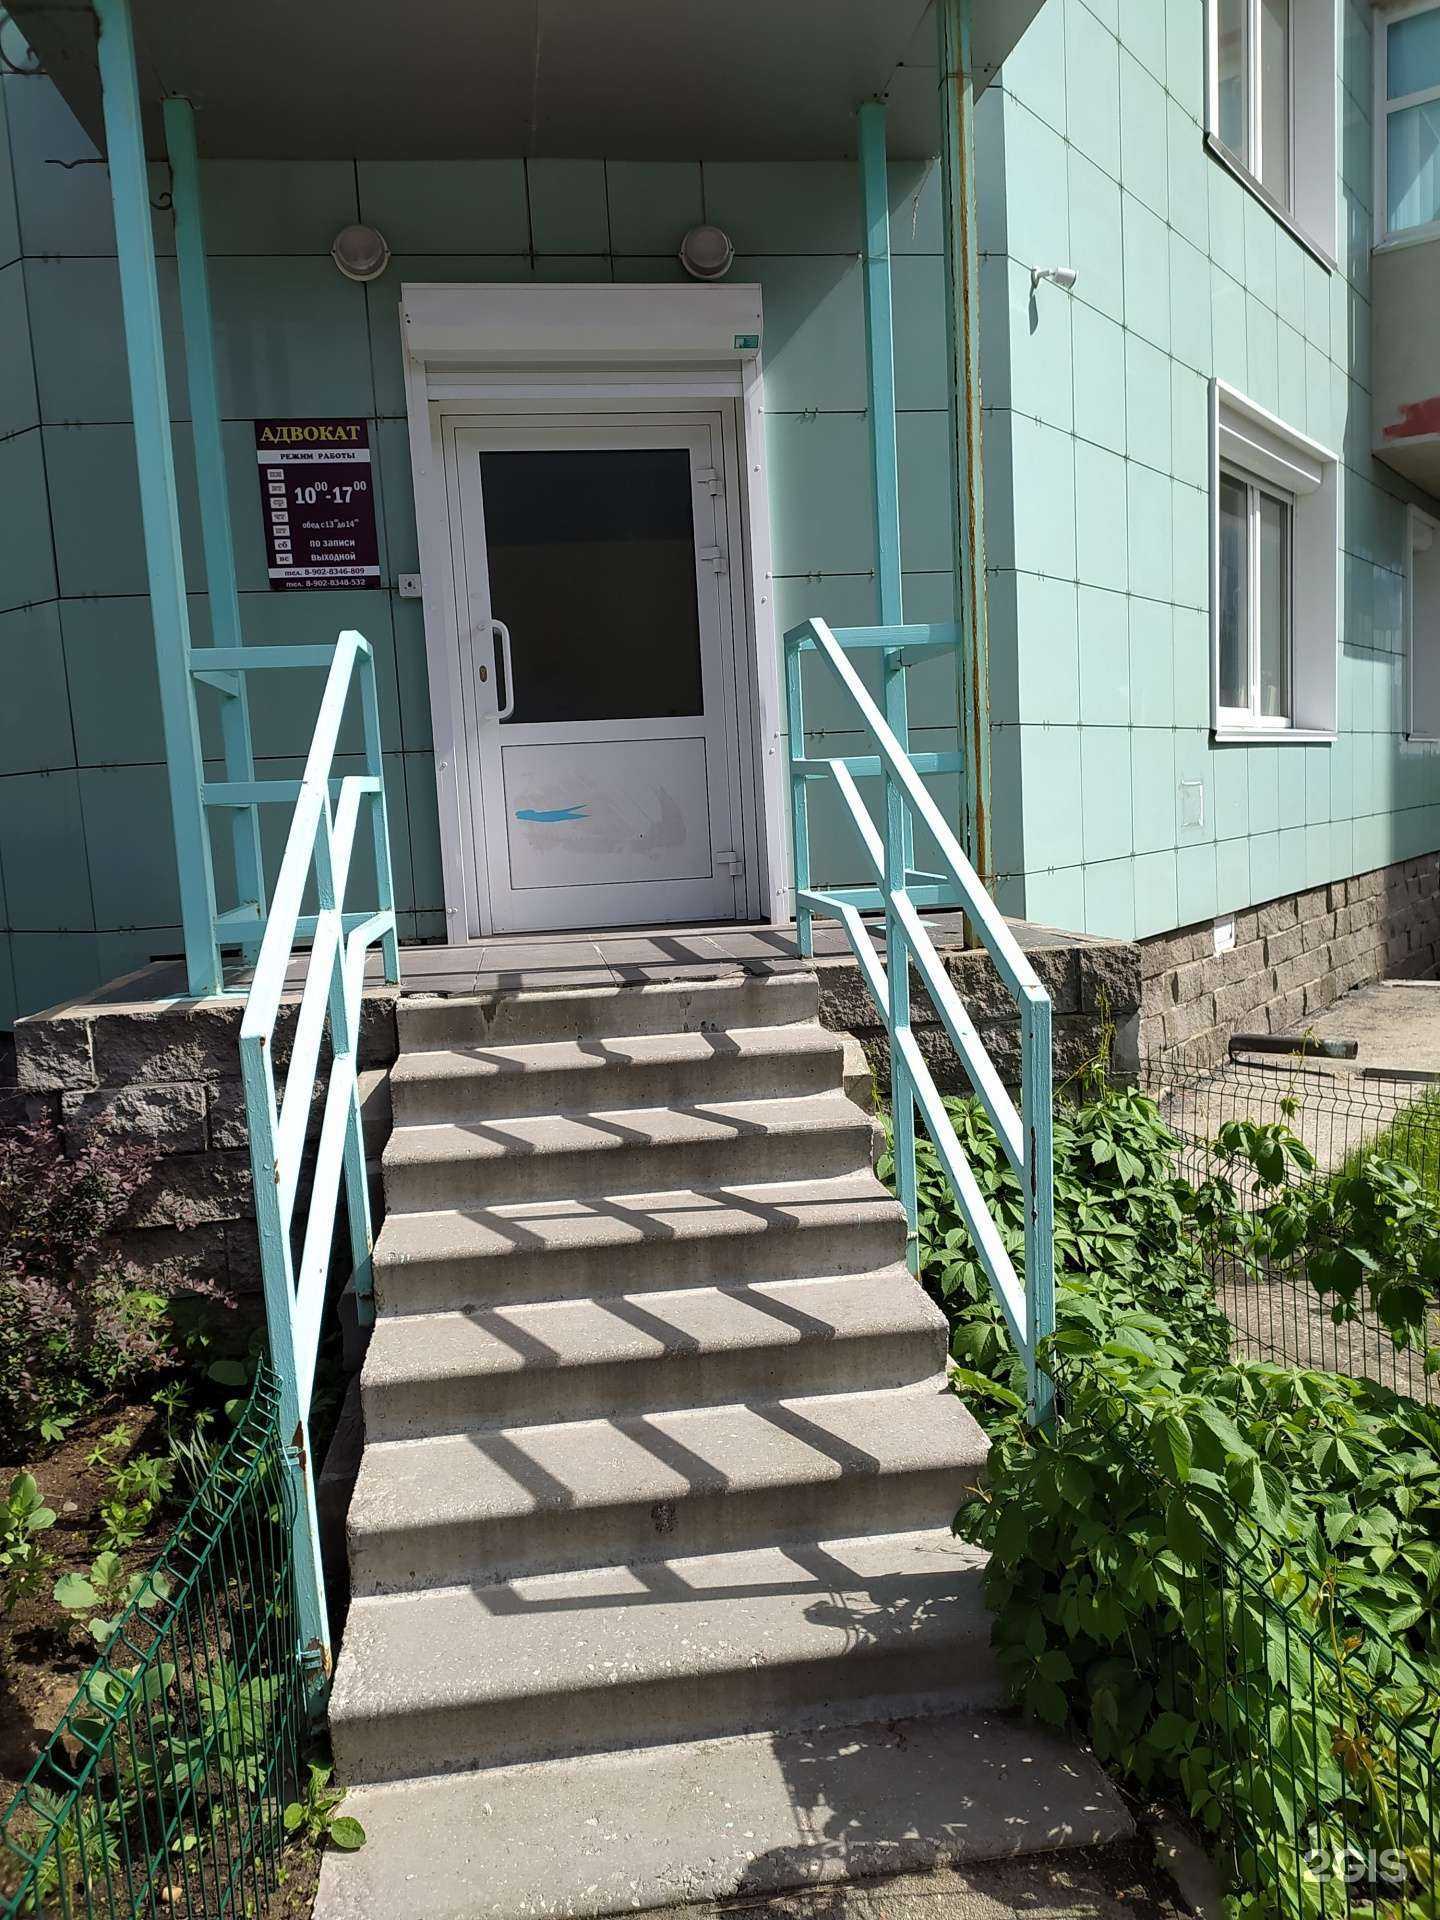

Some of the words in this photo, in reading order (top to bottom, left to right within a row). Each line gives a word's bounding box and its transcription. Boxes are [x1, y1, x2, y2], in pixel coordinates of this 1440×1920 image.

[260, 425, 361, 444] АДВОКАТ
[302, 520, 320, 529] обед
[278, 541, 288, 549] сб
[322, 539, 355, 547] записи
[311, 552, 356, 562] выходной
